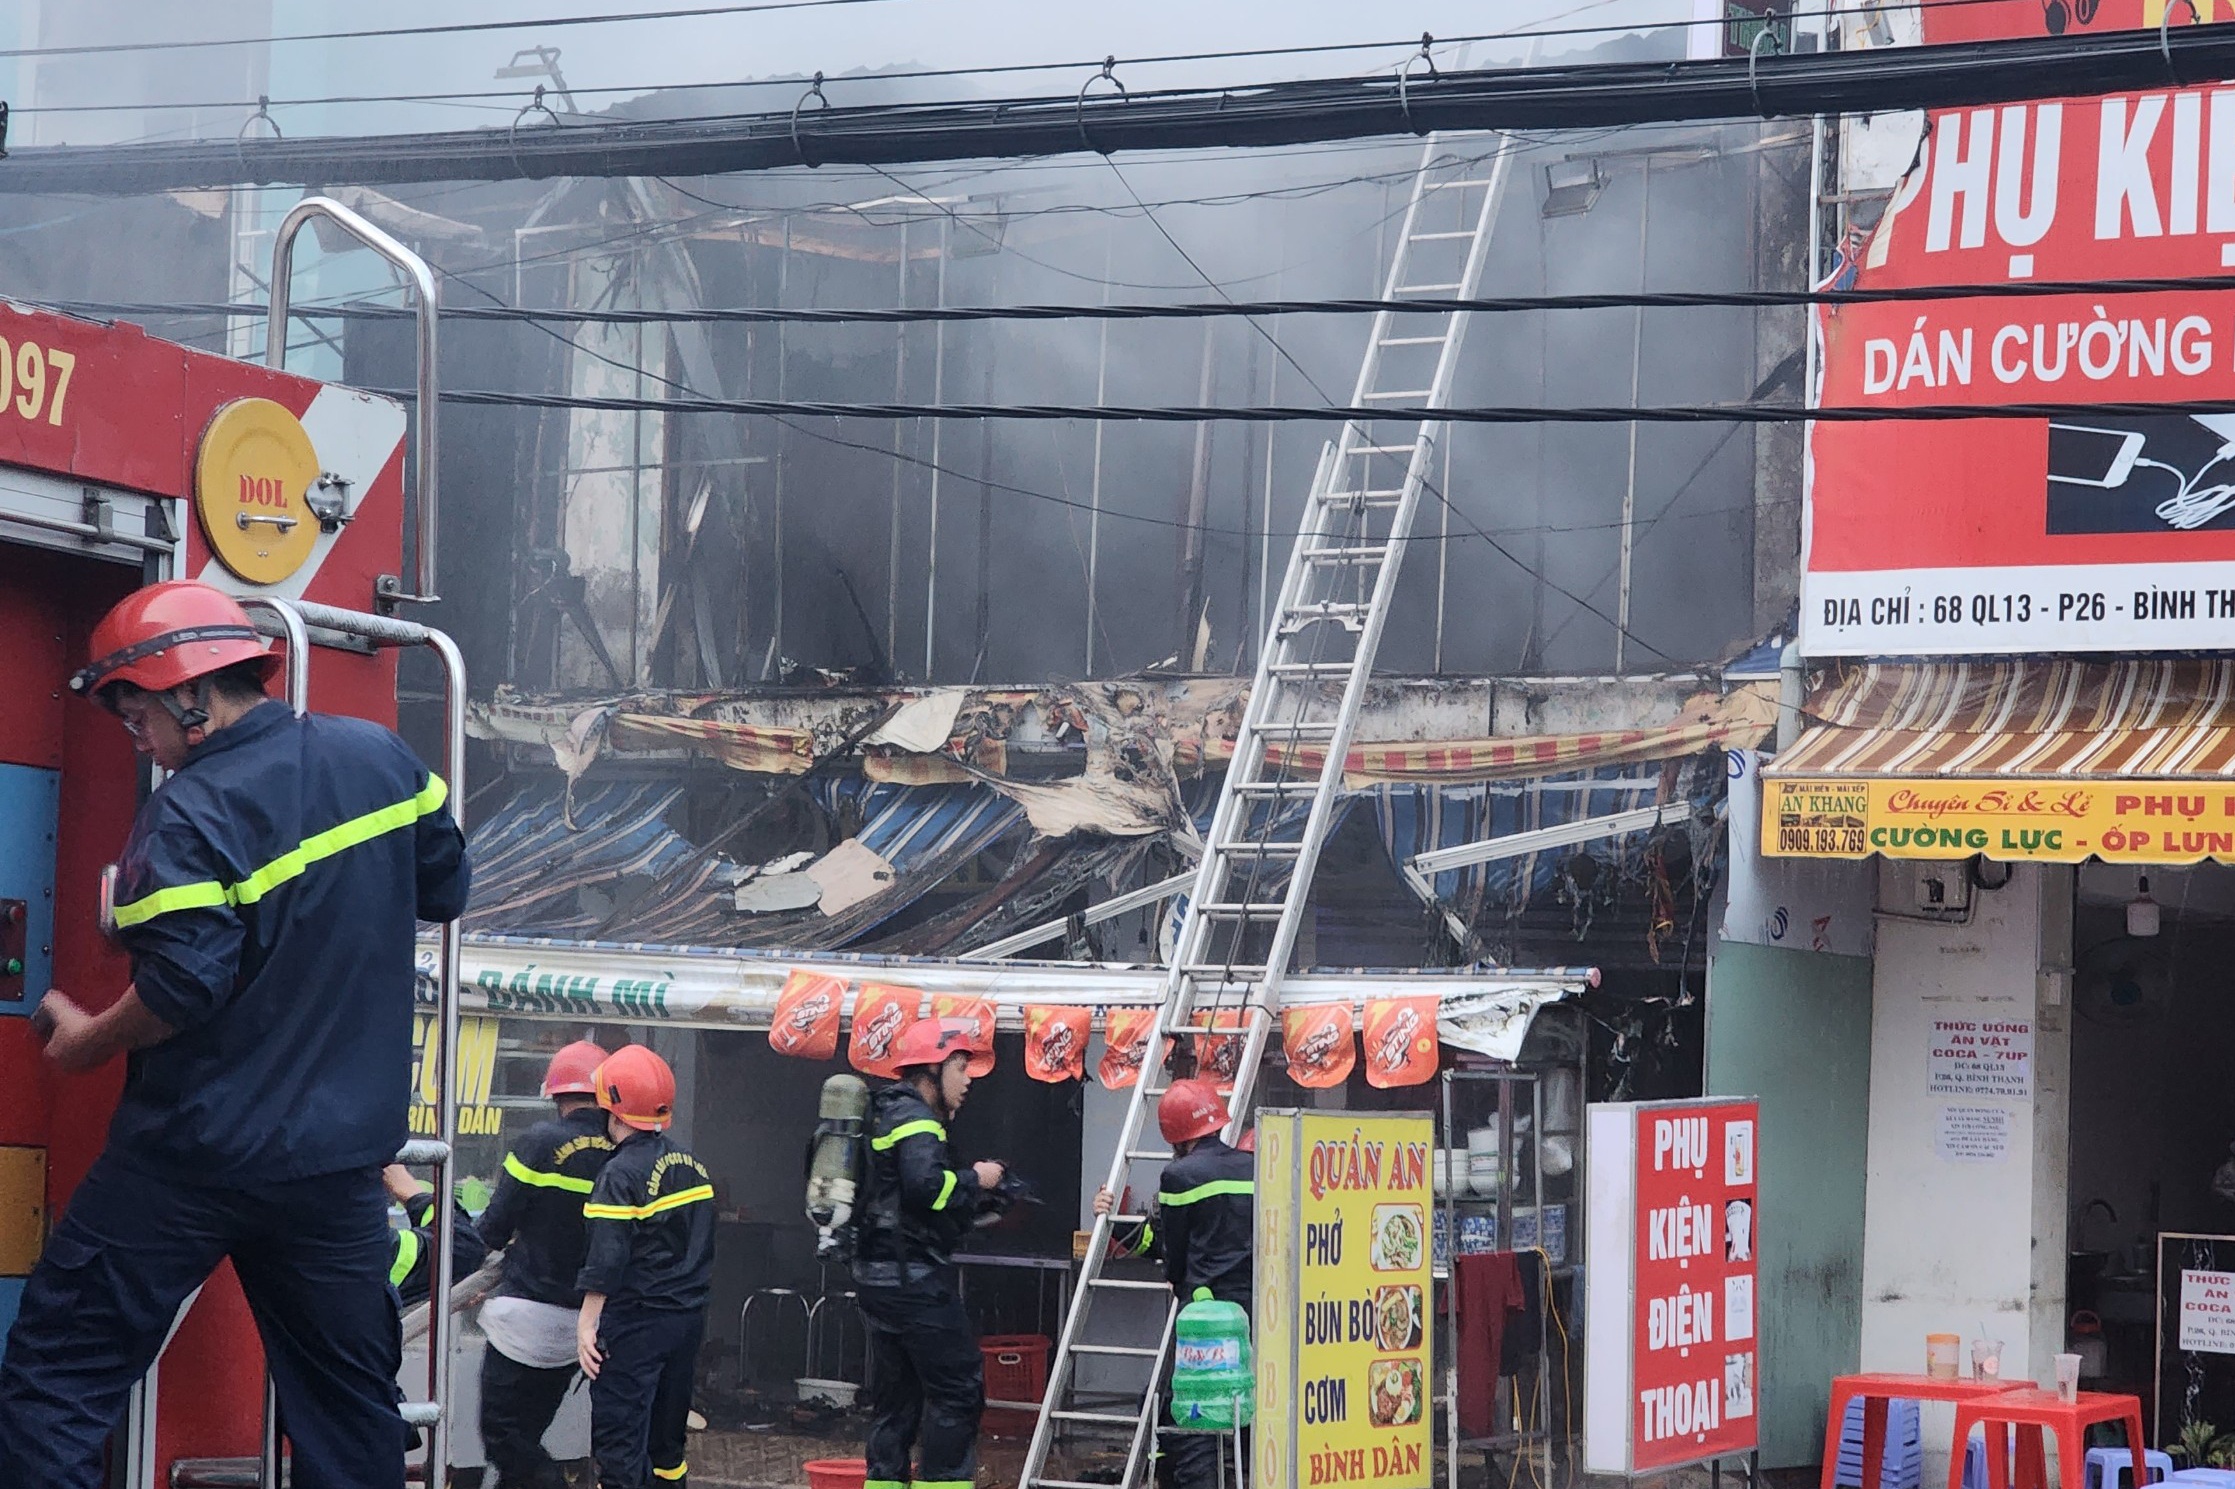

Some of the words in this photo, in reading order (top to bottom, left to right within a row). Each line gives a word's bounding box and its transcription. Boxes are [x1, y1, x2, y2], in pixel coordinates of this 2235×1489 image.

[1864, 316, 1973, 395] DÁN
[1990, 305, 2212, 384] CƯỜNG
[0, 335, 76, 426] 097
[238, 473, 289, 508] DOL
[1823, 597, 1862, 632] ĐỊA
[1871, 585, 1911, 625] CHỈ
[1934, 596, 1963, 624] 68
[1971, 593, 2032, 624] QL13
[2058, 592, 2106, 622] P26
[2133, 584, 2197, 620] BÌNH
[2205, 589, 2235, 619] TH
[1781, 795, 1804, 812] AN
[1809, 795, 1867, 813] KHANG
[1886, 789, 1970, 819] Chuyên
[2017, 790, 2046, 812] &
[2115, 795, 2205, 822] PHỤ
[1780, 828, 1865, 852] 0909.193.769
[1870, 823, 1990, 850] CƯỜNG
[2001, 827, 2064, 855] LỰC
[2100, 823, 2152, 853] ỐP
[612, 971, 675, 1018] MÌ
[1932, 1048, 1977, 1059] COCA
[1996, 1051, 2029, 1061] 7UP
[457, 1103, 503, 1136] DÂN
[1653, 1117, 1708, 1178] PHỤ
[1306, 1208, 1342, 1267] PHỞ
[1649, 1195, 1712, 1269] KIỆN
[1305, 1290, 1342, 1346] BÚN
[1348, 1287, 1376, 1341] BÒ
[1648, 1283, 1713, 1358] ĐIỆN
[2185, 1301, 2231, 1313] COCA
[1304, 1375, 1347, 1426] CƠM
[1640, 1377, 1720, 1443] THOẠI
[1308, 1445, 1365, 1486] BÌNH
[1372, 1436, 1422, 1480] DÂN
